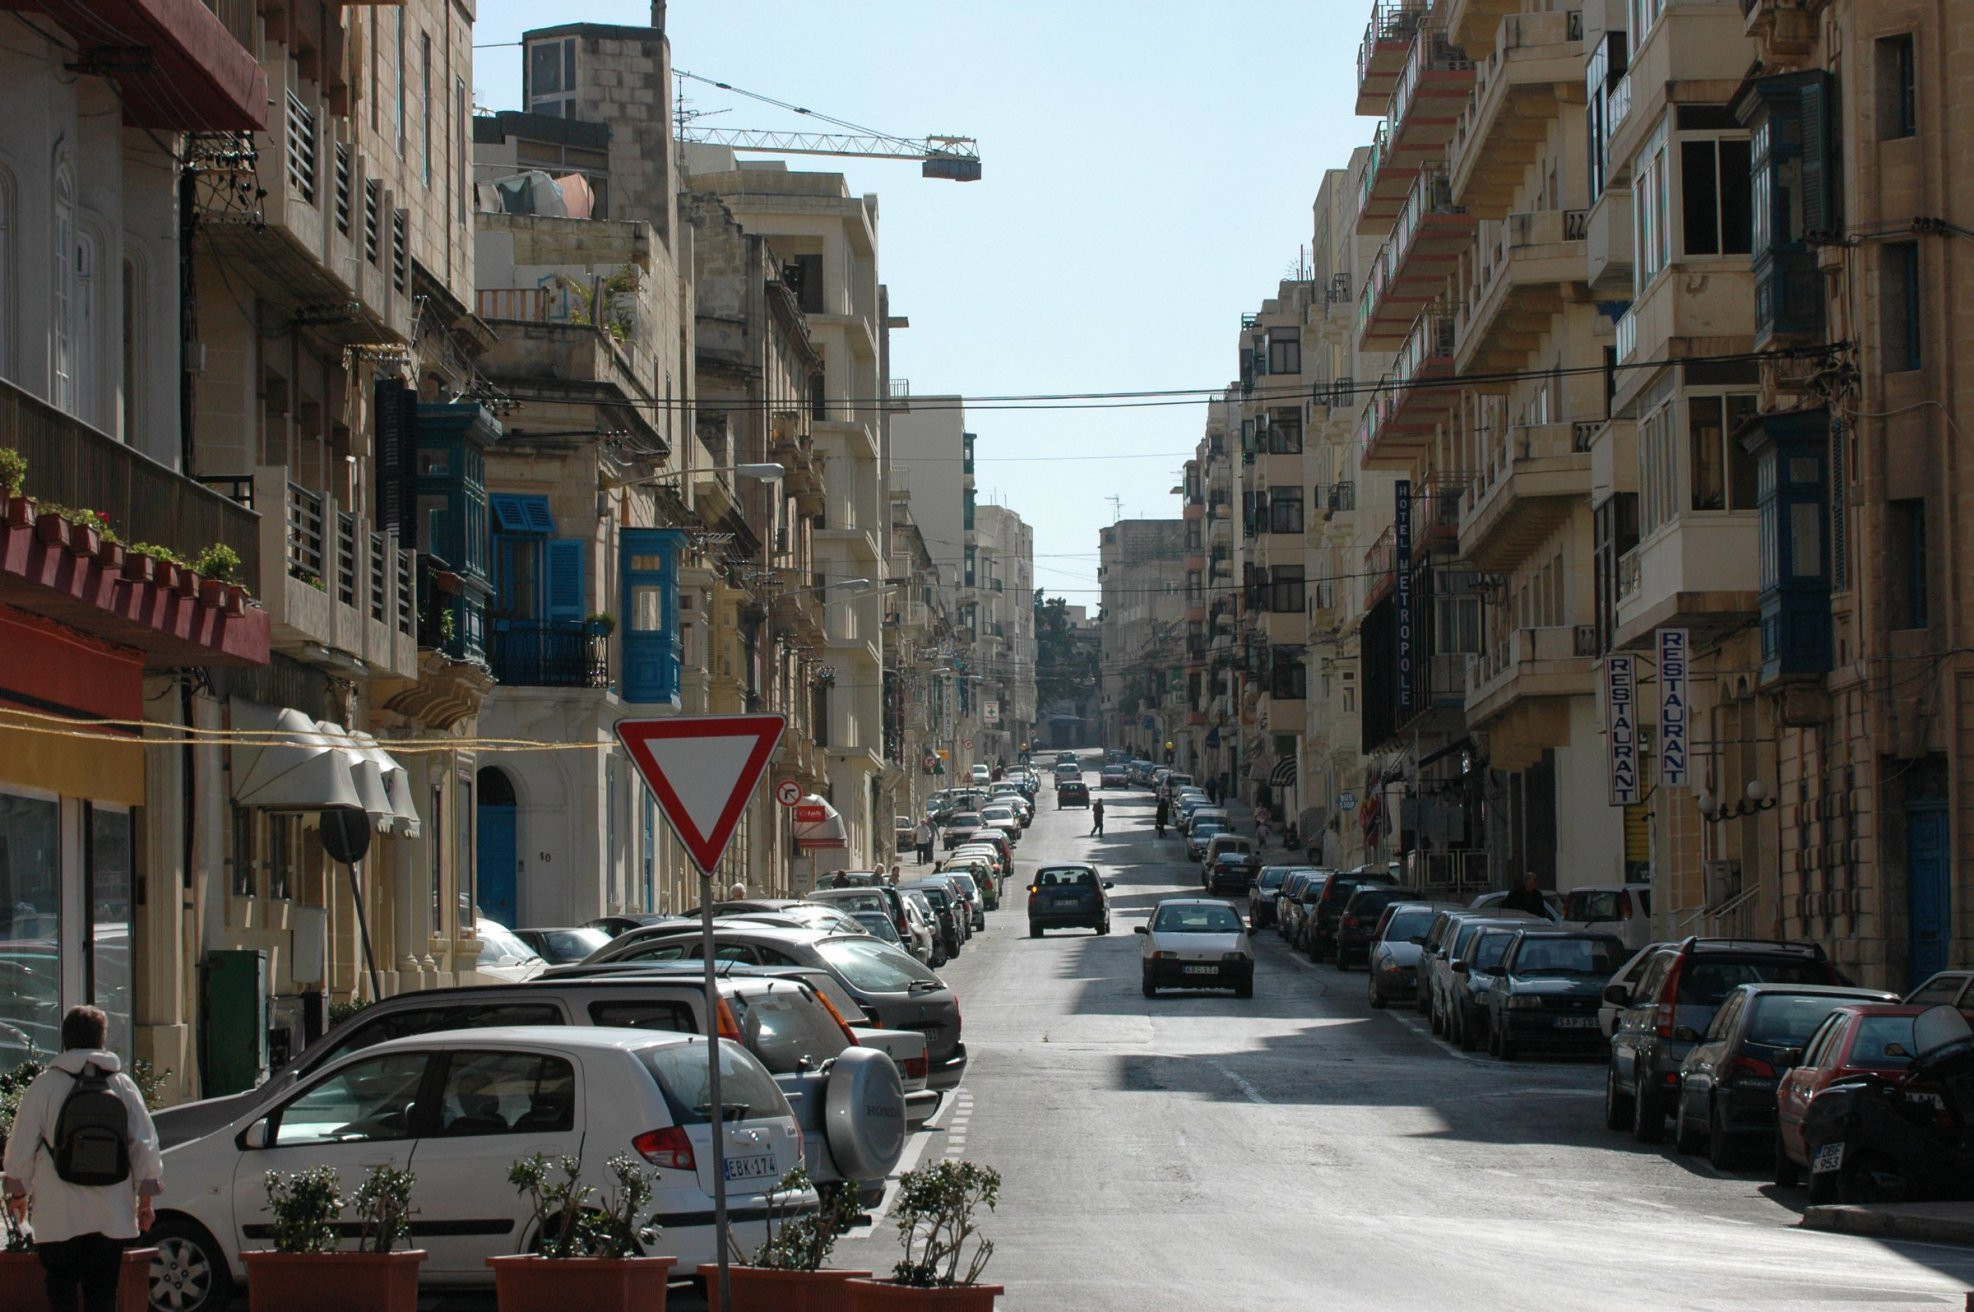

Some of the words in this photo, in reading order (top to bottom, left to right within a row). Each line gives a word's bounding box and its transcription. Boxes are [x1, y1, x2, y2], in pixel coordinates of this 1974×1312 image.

[1398, 485, 1408, 548] HOTEL
[1399, 559, 1411, 705] METROPOLE
[1610, 658, 1634, 802] RESTAURANT
[1663, 632, 1684, 784] RESTAURANT
[539, 851, 551, 862] 10
[1820, 1156, 1839, 1169] 953
